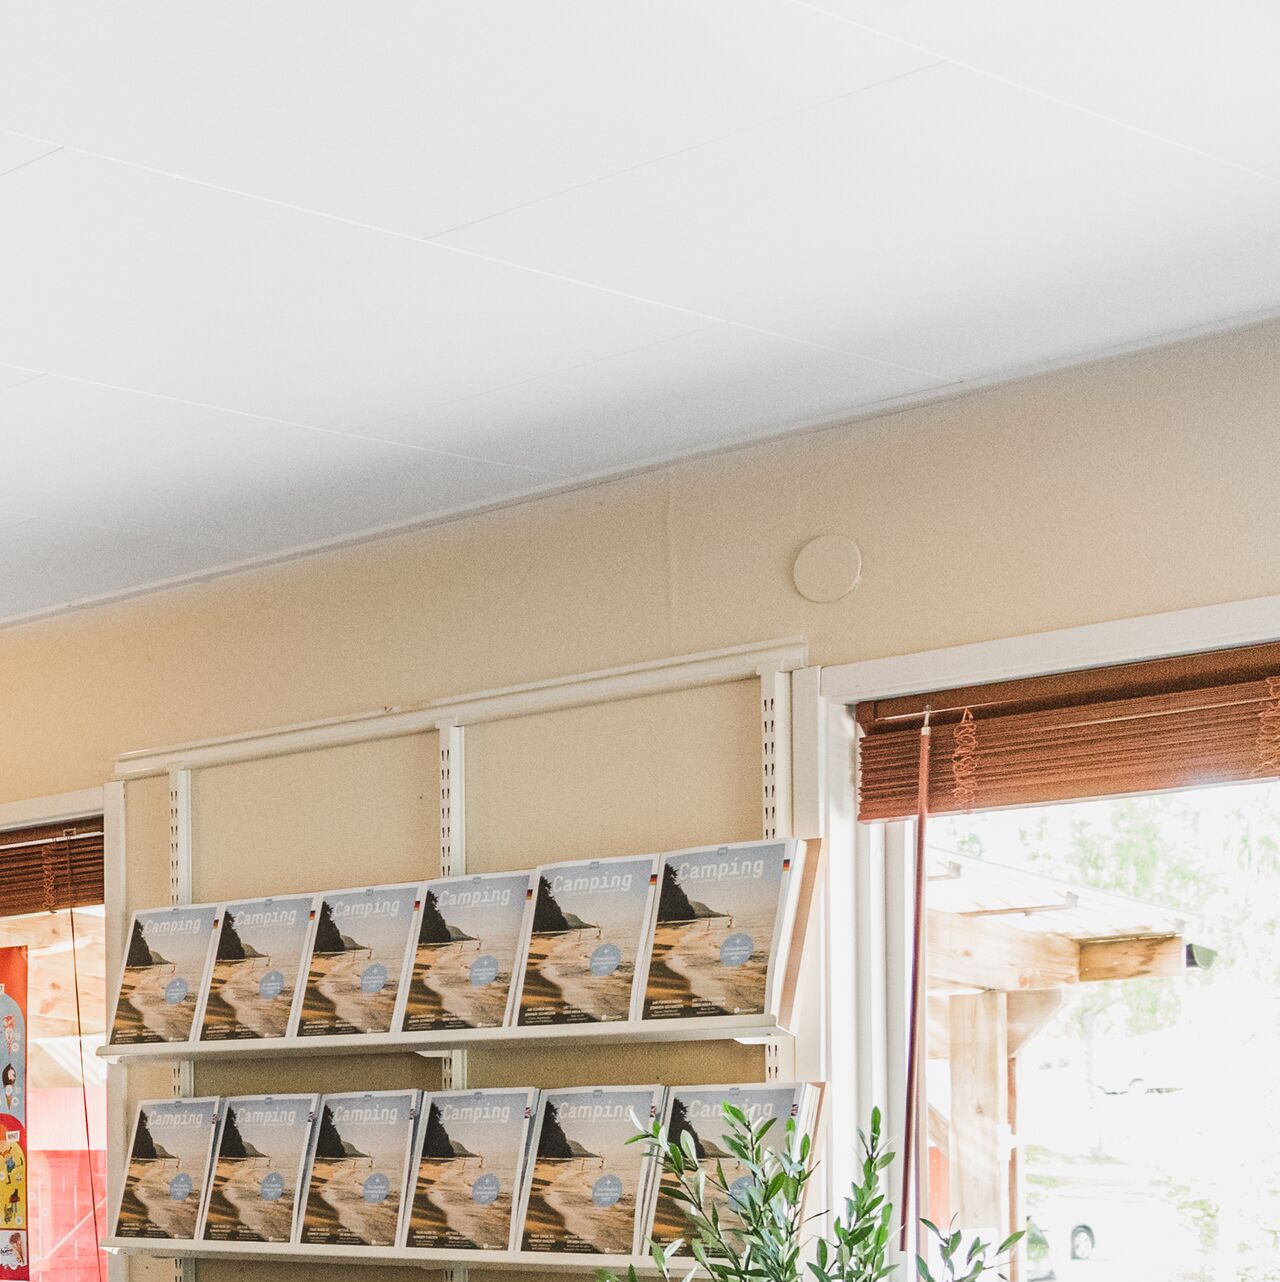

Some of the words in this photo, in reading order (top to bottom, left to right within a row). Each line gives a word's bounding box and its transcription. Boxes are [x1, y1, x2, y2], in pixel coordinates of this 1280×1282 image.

[679, 858, 764, 881] Camping
[553, 872, 632, 894] Camping
[439, 887, 511, 907] Camping
[236, 909, 296, 927] Camping
[334, 898, 400, 918] Camping
[143, 917, 201, 935] Camping
[147, 1110, 203, 1129] Camping
[236, 1107, 296, 1127] Camping
[335, 1104, 398, 1125] Camping
[440, 1102, 510, 1124] Camping
[558, 1100, 635, 1123] Camping
